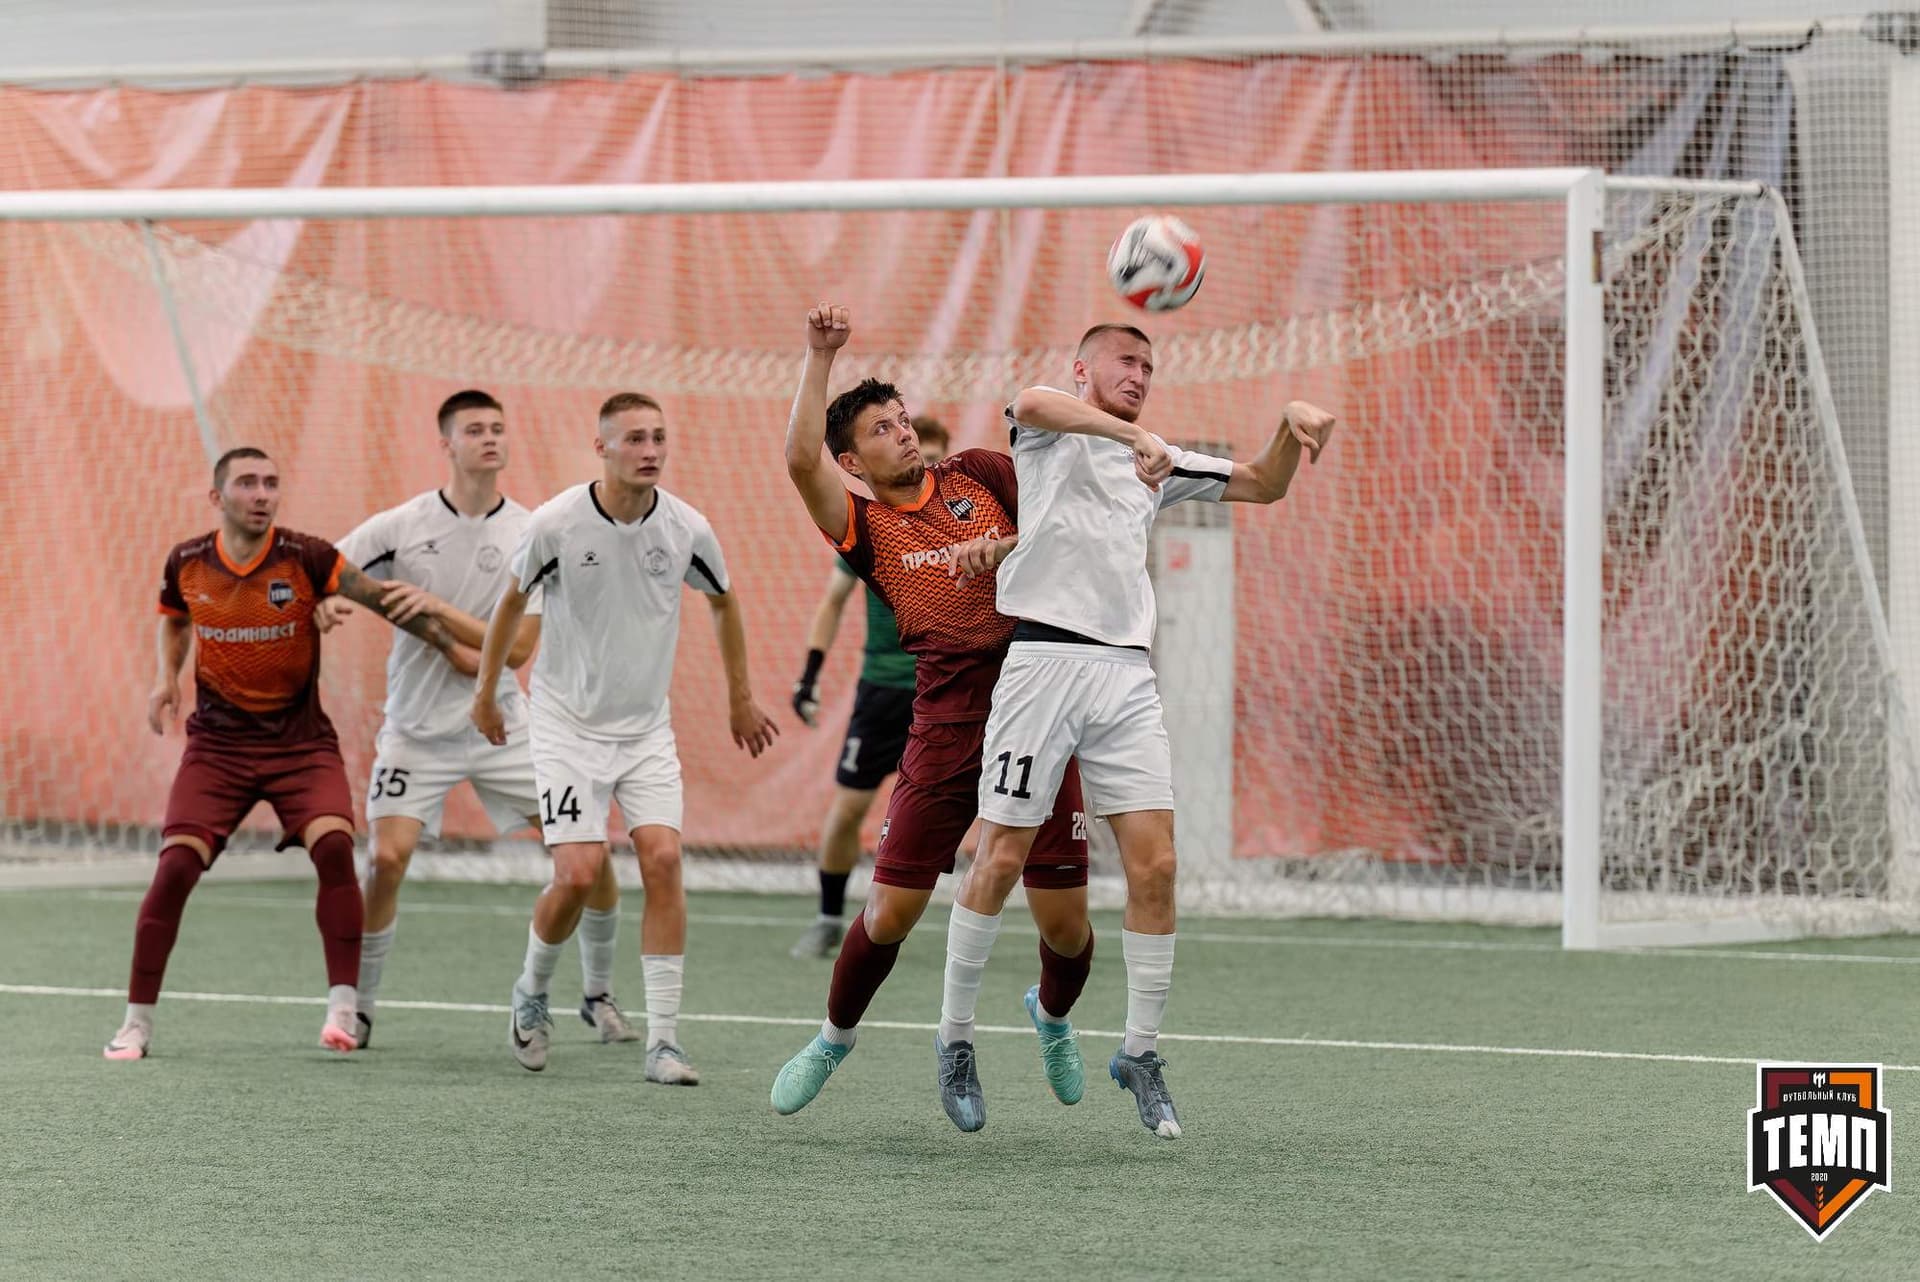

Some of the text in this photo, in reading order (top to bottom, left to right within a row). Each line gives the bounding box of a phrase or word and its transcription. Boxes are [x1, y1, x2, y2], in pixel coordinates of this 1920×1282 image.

[840, 737, 863, 773] 1
[994, 750, 1034, 800] 11
[542, 785, 582, 826] 14
